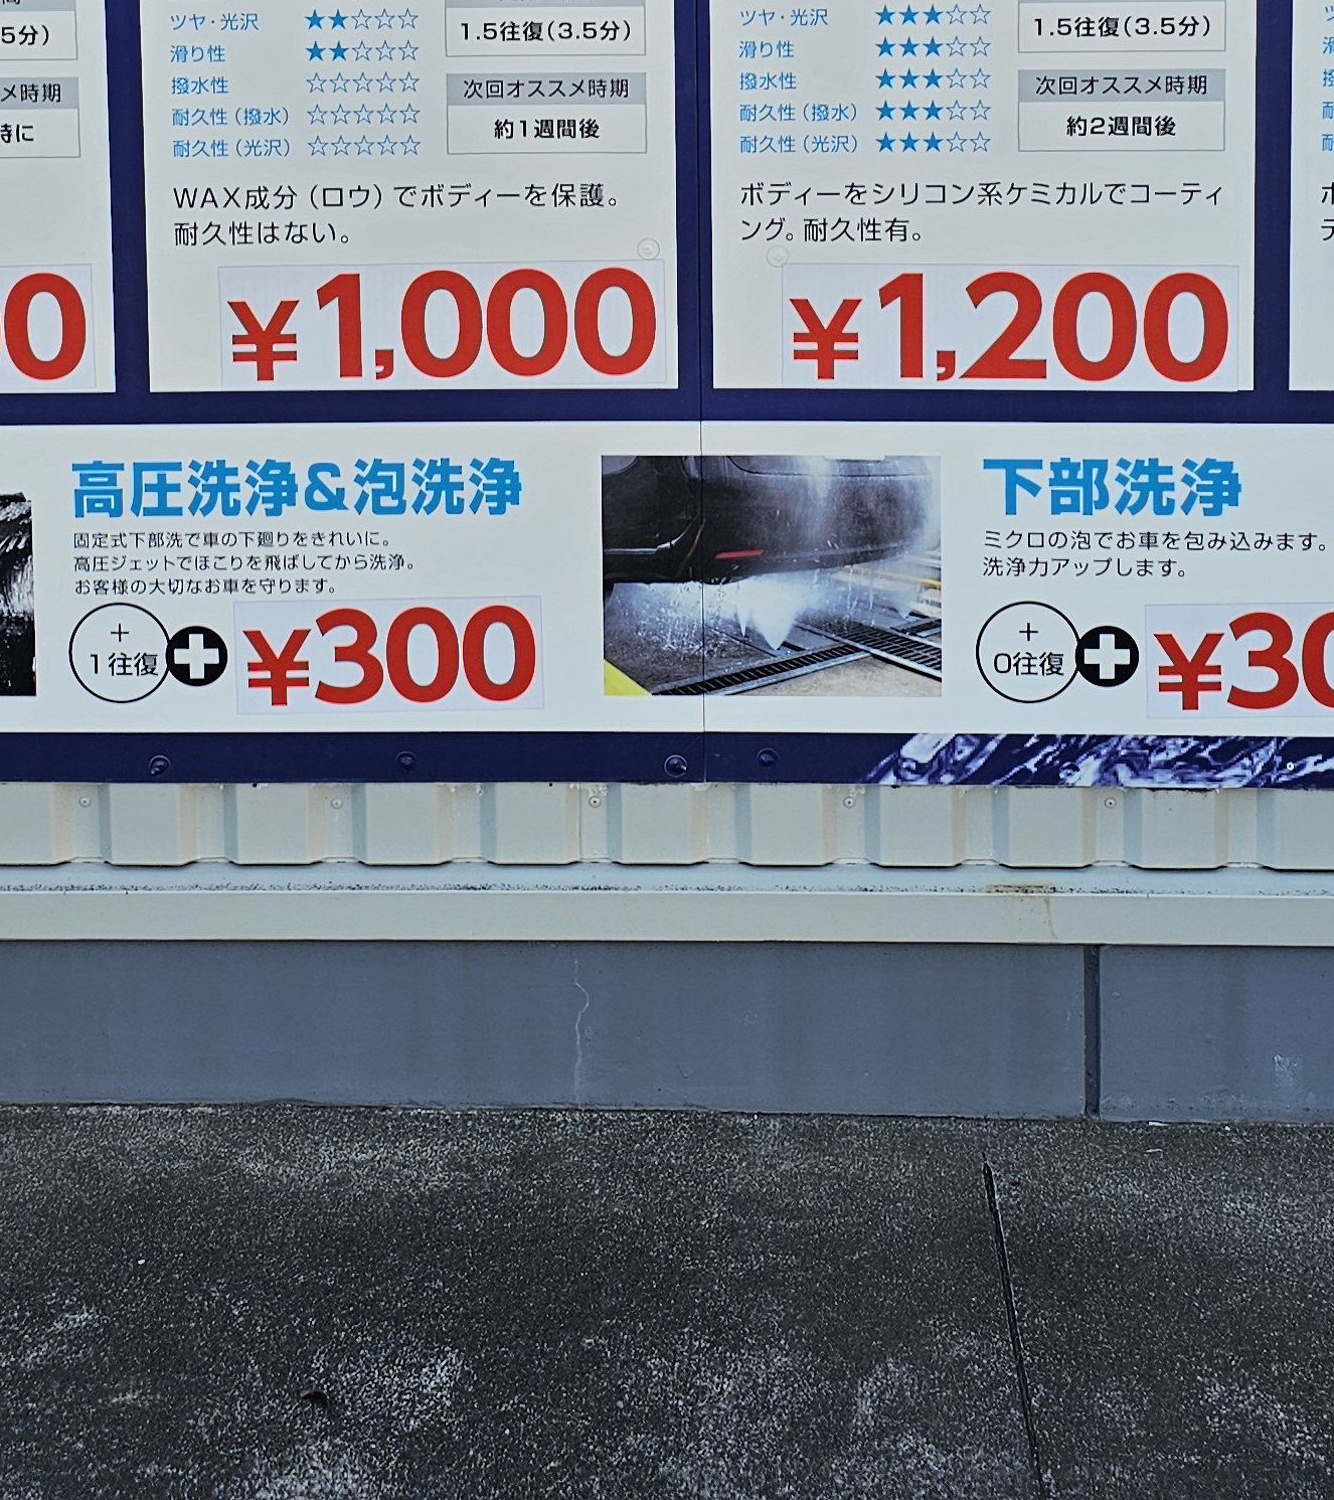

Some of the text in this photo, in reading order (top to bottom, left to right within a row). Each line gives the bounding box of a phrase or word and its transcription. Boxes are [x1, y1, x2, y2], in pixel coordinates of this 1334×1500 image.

[170, 44, 226, 63] 滑り性
[738, 39, 795, 59] 滑り性
[171, 75, 229, 95] 撥水性
[463, 78, 629, 100] 次回オススメ時期
[739, 71, 797, 91] 撥水性
[1035, 74, 1207, 96] 次回オススメ時期
[494, 118, 600, 140] 約1週間後
[1066, 115, 1176, 137] 約2週間後
[740, 181, 1222, 206] ボディーをシリコン系ケミカルでコーティ
[174, 220, 349, 247] 耐久性はない。
[226, 266, 657, 382] ¥1,000
[788, 271, 1229, 383] ¥1,200
[71, 456, 523, 519] 高圧洗浄&泡洗浄
[982, 457, 1242, 517] 下部洗浄
[73, 530, 389, 549] 固定式下部洗で車の下廻りをきれいに。
[984, 530, 1326, 552] ミクロの泡でお車を包み込みます。
[74, 553, 414, 573] 高圧ジェットでほこりを飛ばしてから洗浄。
[982, 556, 1185, 578] 洗浄力アップします。
[75, 577, 335, 596] お客様の大切なお車を守ります。
[242, 604, 536, 707] ¥300
